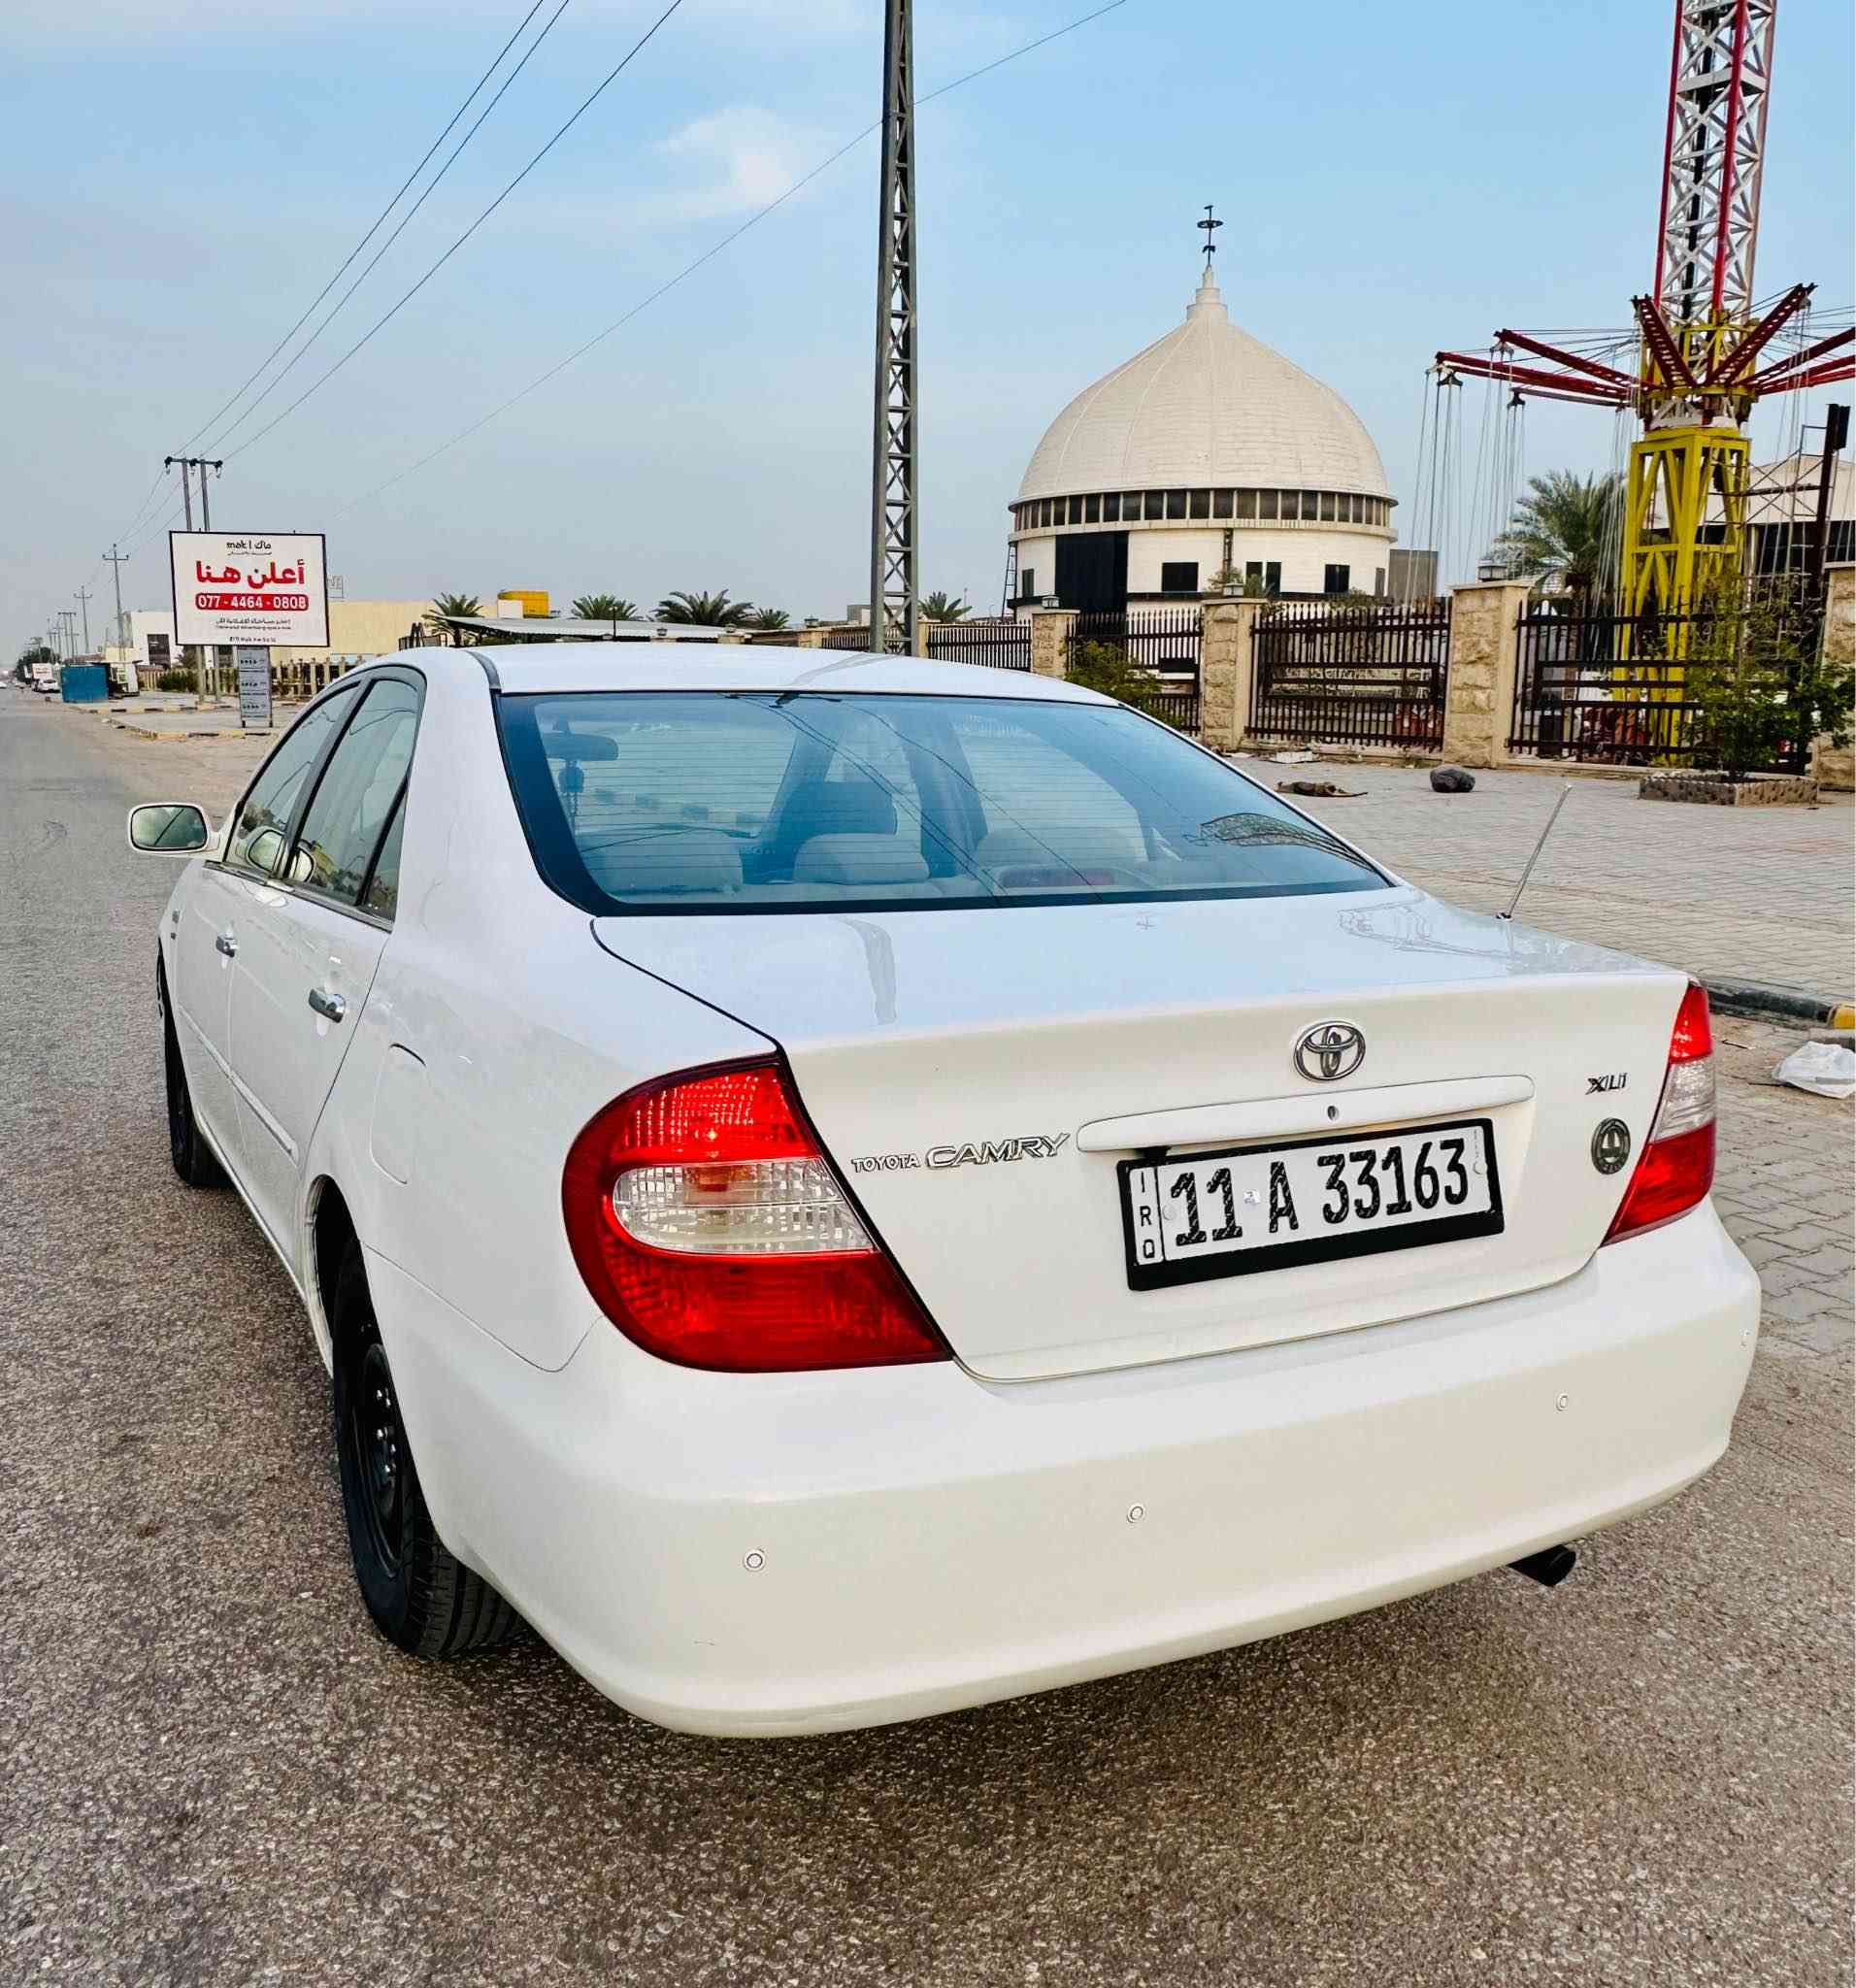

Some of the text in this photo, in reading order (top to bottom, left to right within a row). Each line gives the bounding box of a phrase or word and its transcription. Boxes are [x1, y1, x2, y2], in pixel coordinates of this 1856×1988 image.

[196, 560, 242, 583] هنا
[248, 559, 305, 589] أعلن
[198, 595, 219, 609] 077
[231, 595, 263, 609] 4464
[851, 1133, 1070, 1173] TOYOTA CAMRY
[1171, 1168, 1243, 1246] 11
[1269, 1161, 1299, 1233] A
[1317, 1138, 1468, 1224] 33163
